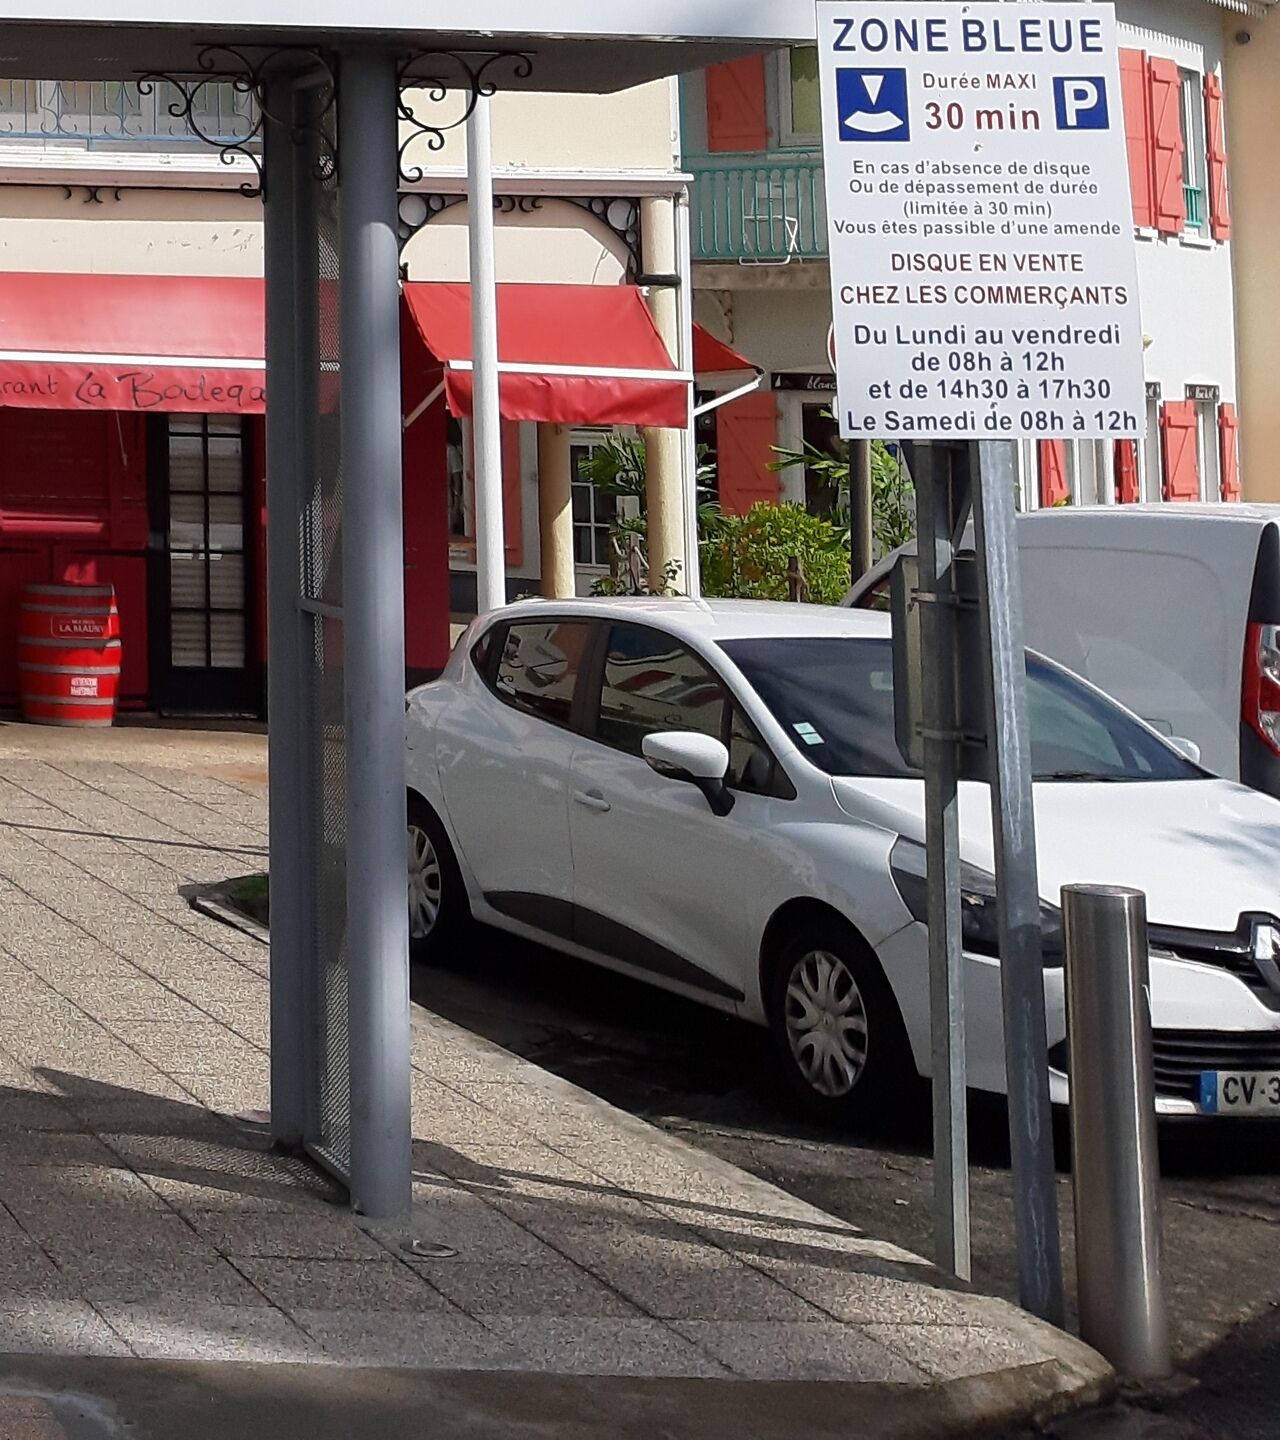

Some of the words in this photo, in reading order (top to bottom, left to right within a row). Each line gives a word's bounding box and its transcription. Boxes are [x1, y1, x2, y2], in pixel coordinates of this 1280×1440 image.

[832, 18, 949, 52] ZONE
[962, 19, 1103, 53] BLEUE
[923, 72, 981, 90] Durée
[987, 73, 1037, 90] MAXI
[1063, 80, 1099, 127] P
[925, 102, 964, 130] 30
[976, 102, 1040, 130] min
[853, 160, 875, 174] En
[880, 164, 910, 175] cas
[915, 160, 1002, 175] d'absence
[1007, 161, 1028, 175] de
[1033, 161, 1091, 179] disque
[849, 179, 874, 193] Ou
[879, 179, 899, 194] de
[904, 179, 1019, 197] dépassement
[1024, 179, 1044, 194] de
[1049, 179, 1098, 194] durée
[903, 200, 970, 219] (limitée
[975, 201, 983, 215] à
[988, 202, 1009, 216] 30
[1013, 201, 1053, 219] min)
[834, 220, 877, 234] Vous
[882, 220, 918, 235] êtes
[923, 220, 995, 238] passible
[1001, 220, 1048, 235] d'une
[1053, 220, 1121, 235] amende
[891, 253, 972, 272] DISQUE
[979, 253, 1007, 271] EN
[1013, 253, 1084, 272] VENTE
[840, 285, 900, 304] CHEZ
[906, 285, 947, 303] LES
[954, 285, 1128, 309] COMMERÇANTS
[854, 325, 887, 344] Du
[896, 325, 966, 344] Lundi
[974, 329, 1004, 344] au
[1012, 324, 1121, 344] vendredi
[911, 352, 940, 371] de
[948, 351, 992, 371] 08h
[1000, 351, 1013, 371] à
[1021, 351, 1065, 371] 12h
[75, 371, 106, 403] La
[868, 380, 893, 399] et
[899, 379, 928, 399] de
[936, 379, 1008, 399] 14h30
[1016, 378, 1030, 400] à
[1038, 379, 1111, 399] 17h30
[848, 411, 876, 431] Le
[884, 411, 976, 431] Samedi
[984, 410, 1013, 431] de
[1020, 410, 1065, 431] 08h
[1072, 409, 1087, 431] à
[1093, 410, 1137, 431] 12h
[59, 624, 73, 632] LA
